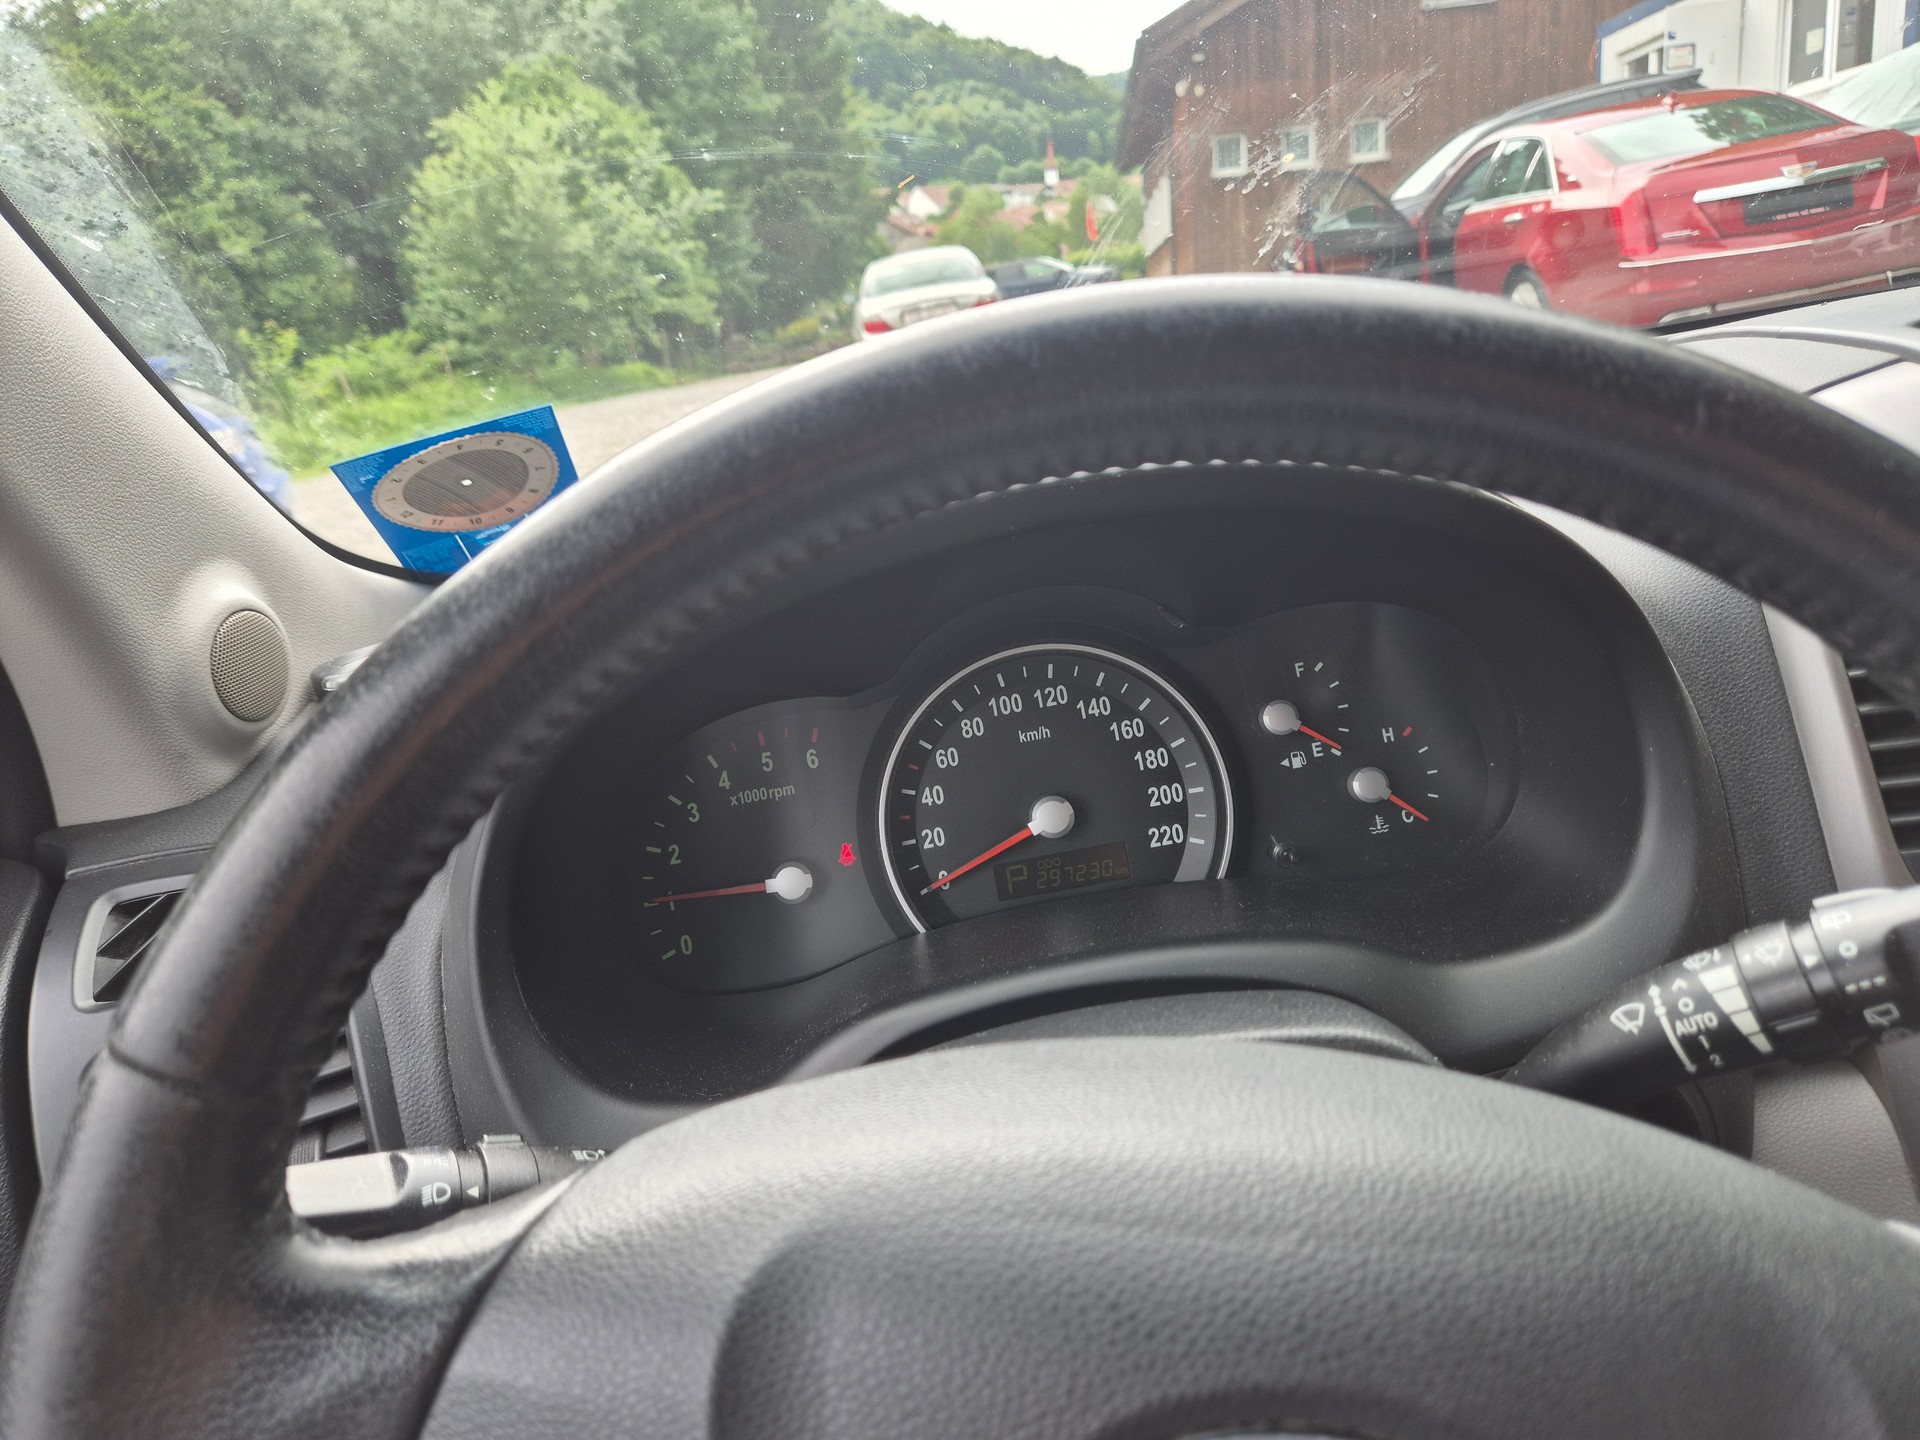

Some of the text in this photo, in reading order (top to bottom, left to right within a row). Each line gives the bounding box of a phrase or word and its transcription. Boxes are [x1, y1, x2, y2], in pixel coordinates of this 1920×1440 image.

[469, 517, 482, 525] 10
[1294, 662, 1304, 678] F
[988, 693, 1023, 716] 100
[1033, 685, 1069, 709] 120
[1076, 696, 1112, 719] 140
[960, 717, 985, 739] 80
[1018, 726, 1051, 744] km/h
[1109, 718, 1145, 742] 160
[1381, 726, 1395, 743] H
[806, 749, 819, 769] 6
[935, 747, 959, 769] 60
[1134, 747, 1169, 771] 180
[1311, 741, 1324, 757] E
[761, 751, 774, 772] 5
[718, 770, 731, 790] 4
[769, 785, 795, 801] rpm
[921, 785, 945, 806] 40
[1147, 782, 1184, 807] 200
[687, 803, 700, 823] 3
[921, 827, 946, 849] 20
[1148, 823, 1184, 849] 220
[668, 845, 682, 865] 2
[1006, 864, 1027, 894] P
[1037, 859, 1113, 889] 297230
[680, 935, 693, 955] 0
[1675, 1011, 1718, 1037] AUTO
[1698, 1034, 1710, 1051] 1
[1709, 1054, 1723, 1068] 2
